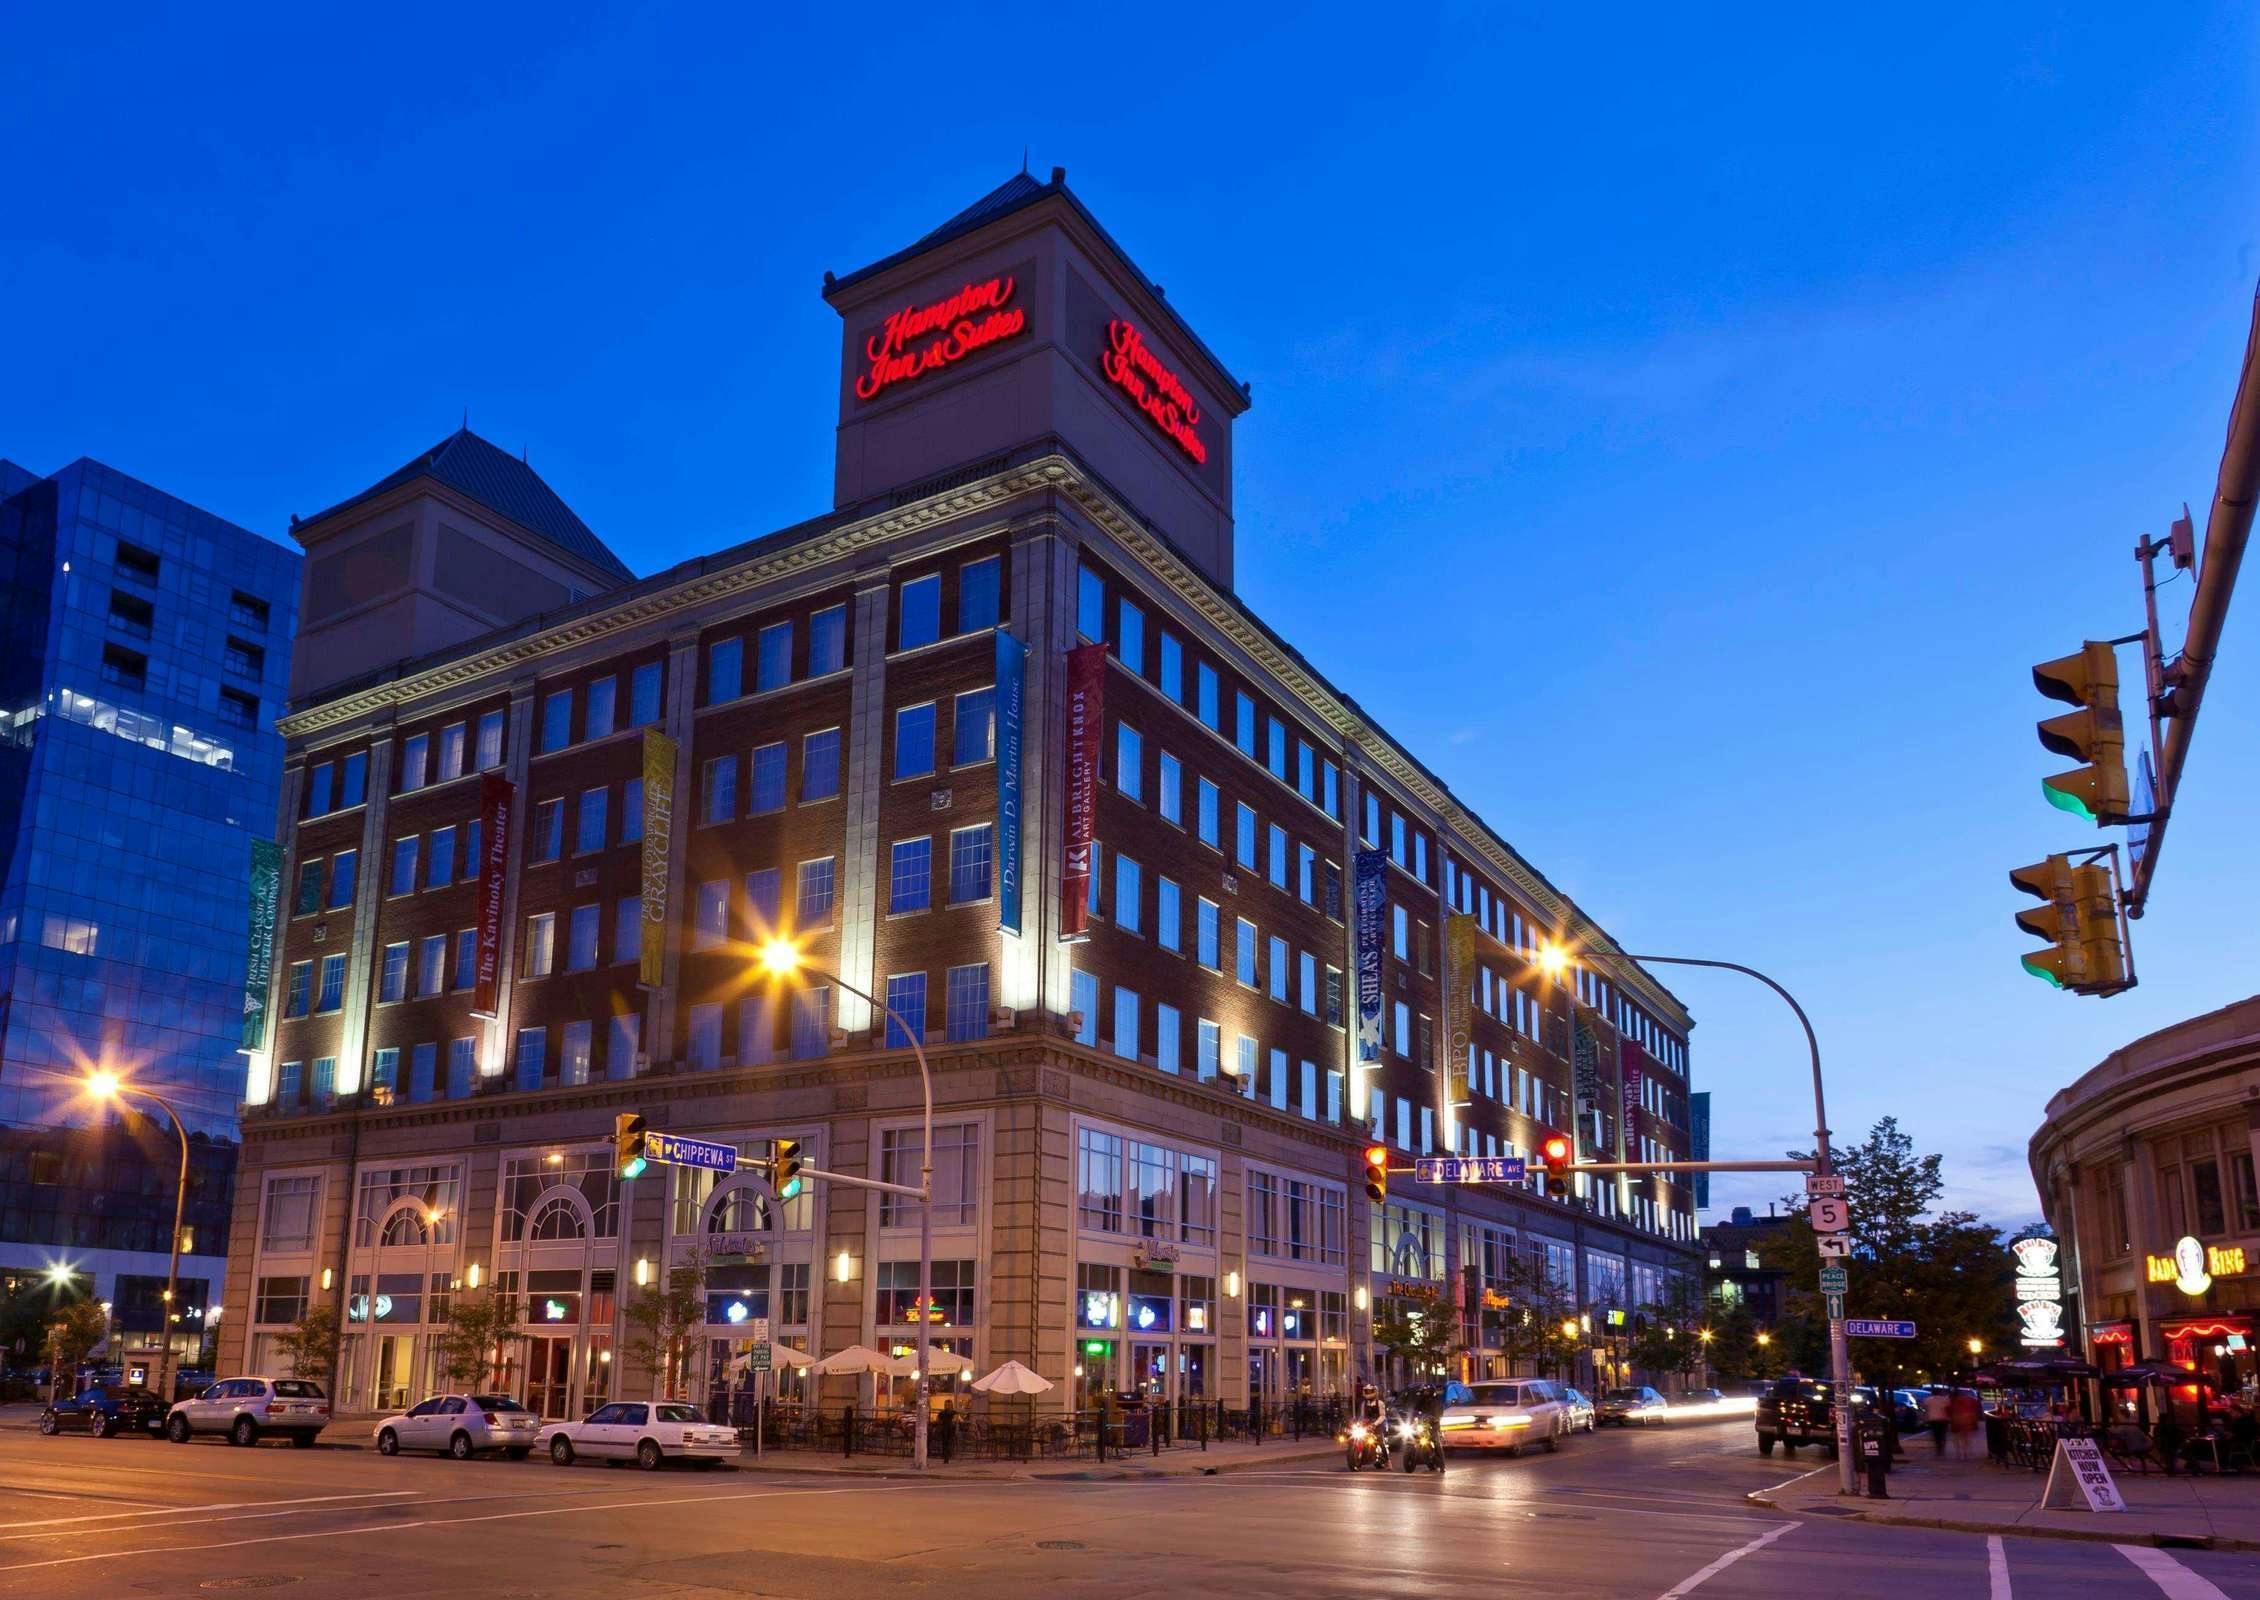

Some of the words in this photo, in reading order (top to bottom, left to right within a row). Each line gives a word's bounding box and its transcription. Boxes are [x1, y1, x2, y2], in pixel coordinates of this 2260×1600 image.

[867, 277, 1013, 361] Hampton
[856, 353, 926, 398] Inn
[944, 309, 1024, 360] Suites
[1110, 320, 1200, 425] Hampton
[1103, 350, 1151, 410] Inn
[1161, 402, 1206, 464] Suites
[1006, 676, 1020, 731] House
[1005, 736, 1018, 792] Martin
[1083, 760, 1091, 813] GALLERY
[1004, 799, 1017, 818] D.
[490, 801, 507, 864] Theater
[1003, 824, 1016, 891] Darwin
[482, 870, 504, 948] Kavinoky
[246, 953, 258, 987] IRISH
[479, 952, 494, 984] The
[1361, 950, 1379, 1007] SHEA'S
[1452, 1031, 1468, 1077] BPO
[673, 1142, 724, 1166] CHIPPEWA
[726, 1155, 734, 1164] ST
[1436, 1161, 1504, 1178] DELAWARE
[1507, 1164, 1521, 1173] AVE
[1811, 1180, 1839, 1190] WEST
[1822, 1204, 1836, 1224] 5
[2146, 1255, 2179, 1282] BADA
[2208, 1246, 2245, 1276] BING
[1849, 1322, 1900, 1335] DELAWARE
[2068, 1449, 2101, 1461] KITCHEN
[2077, 1460, 2101, 1472] NOW
[2082, 1472, 2109, 1485] OPEN
